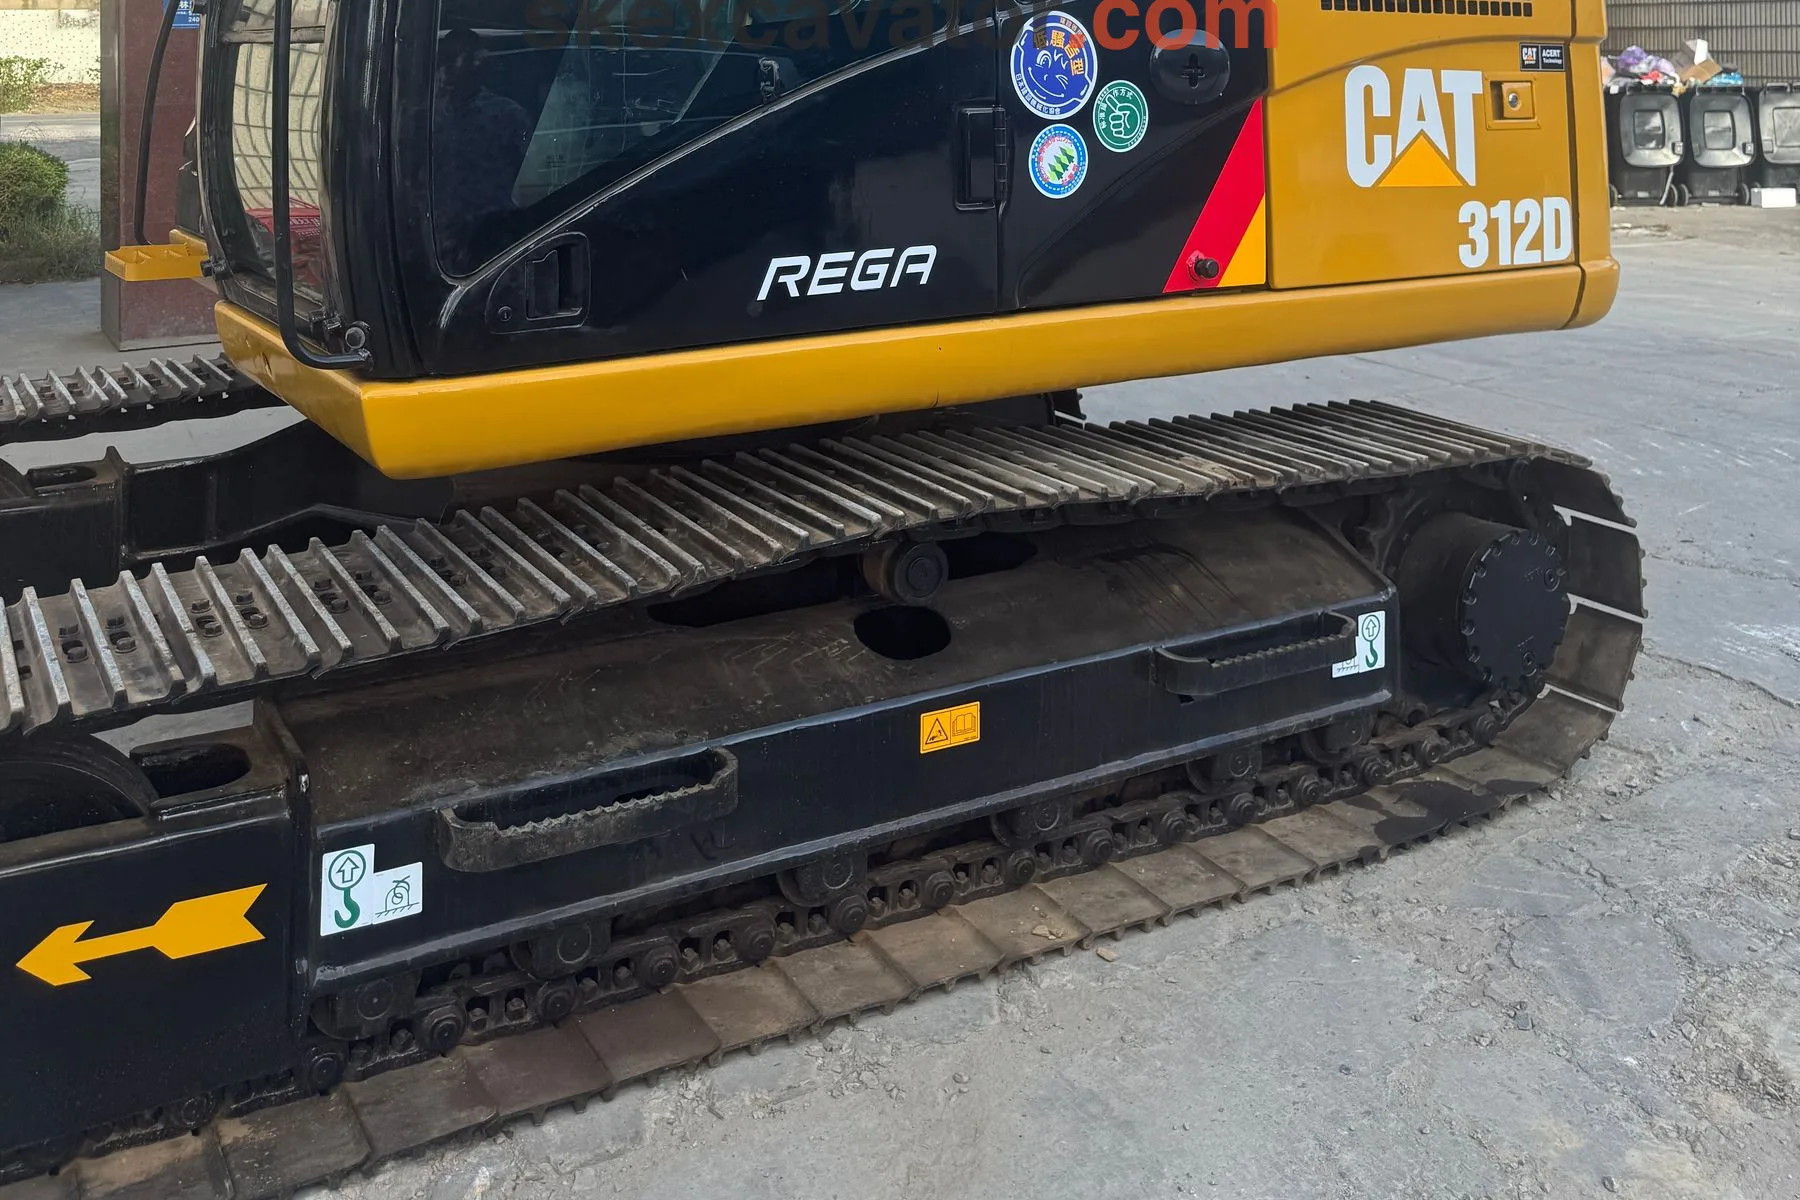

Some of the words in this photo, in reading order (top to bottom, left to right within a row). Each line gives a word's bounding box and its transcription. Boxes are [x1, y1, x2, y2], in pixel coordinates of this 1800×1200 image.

[1522, 47, 1537, 60] CAT
[1542, 49, 1561, 58] ACERT
[1345, 65, 1483, 188] CAT
[1458, 196, 1572, 268] 312D
[757, 244, 937, 301] REGA
